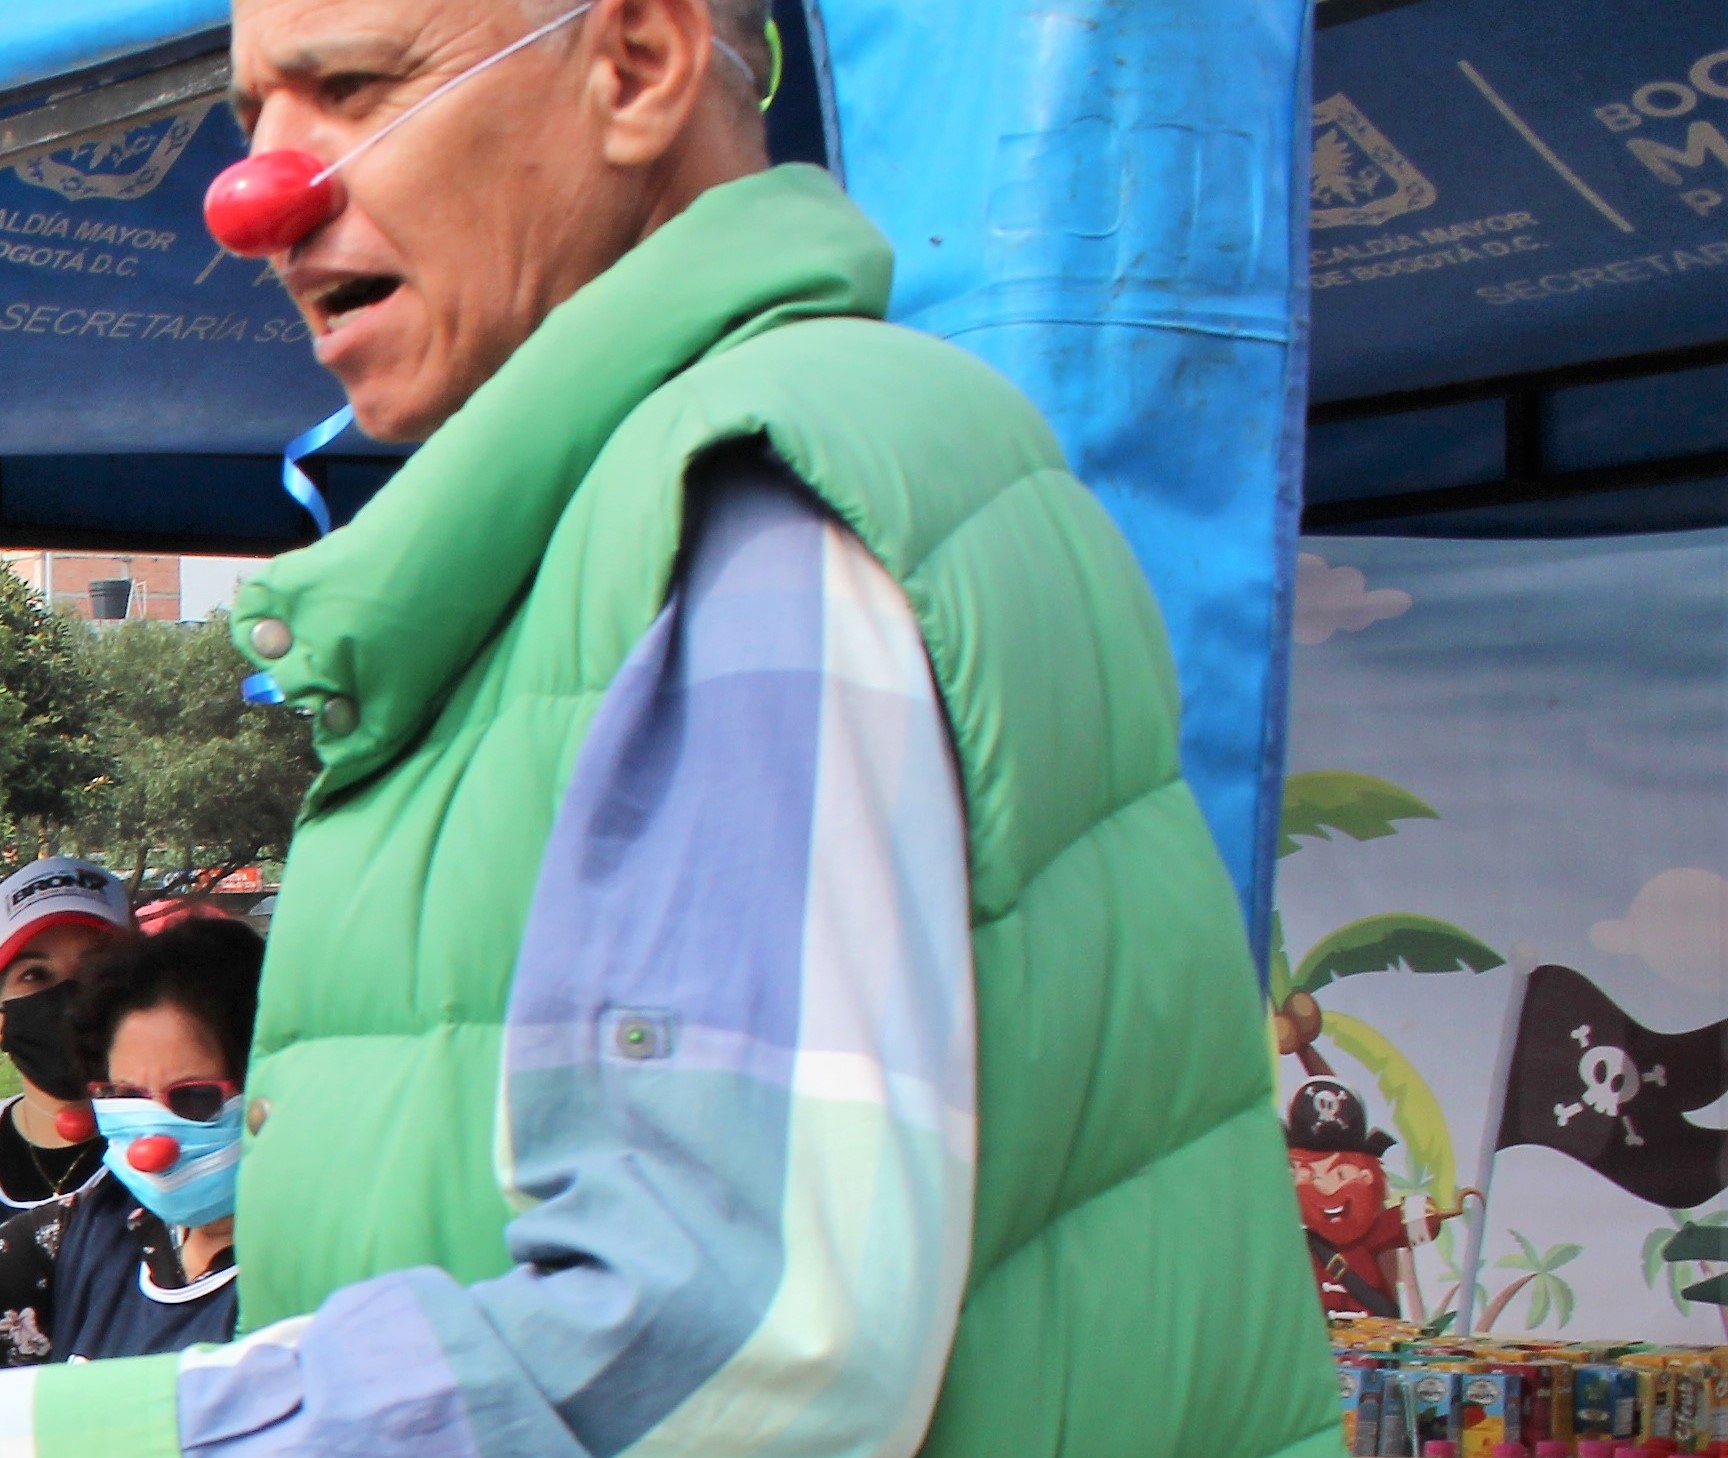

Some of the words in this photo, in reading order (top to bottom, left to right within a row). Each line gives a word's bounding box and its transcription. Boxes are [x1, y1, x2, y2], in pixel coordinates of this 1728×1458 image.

[73, 220, 177, 251] MAYOR
[1419, 210, 1540, 245] MAYOR
[88, 254, 140, 278] D.C.
